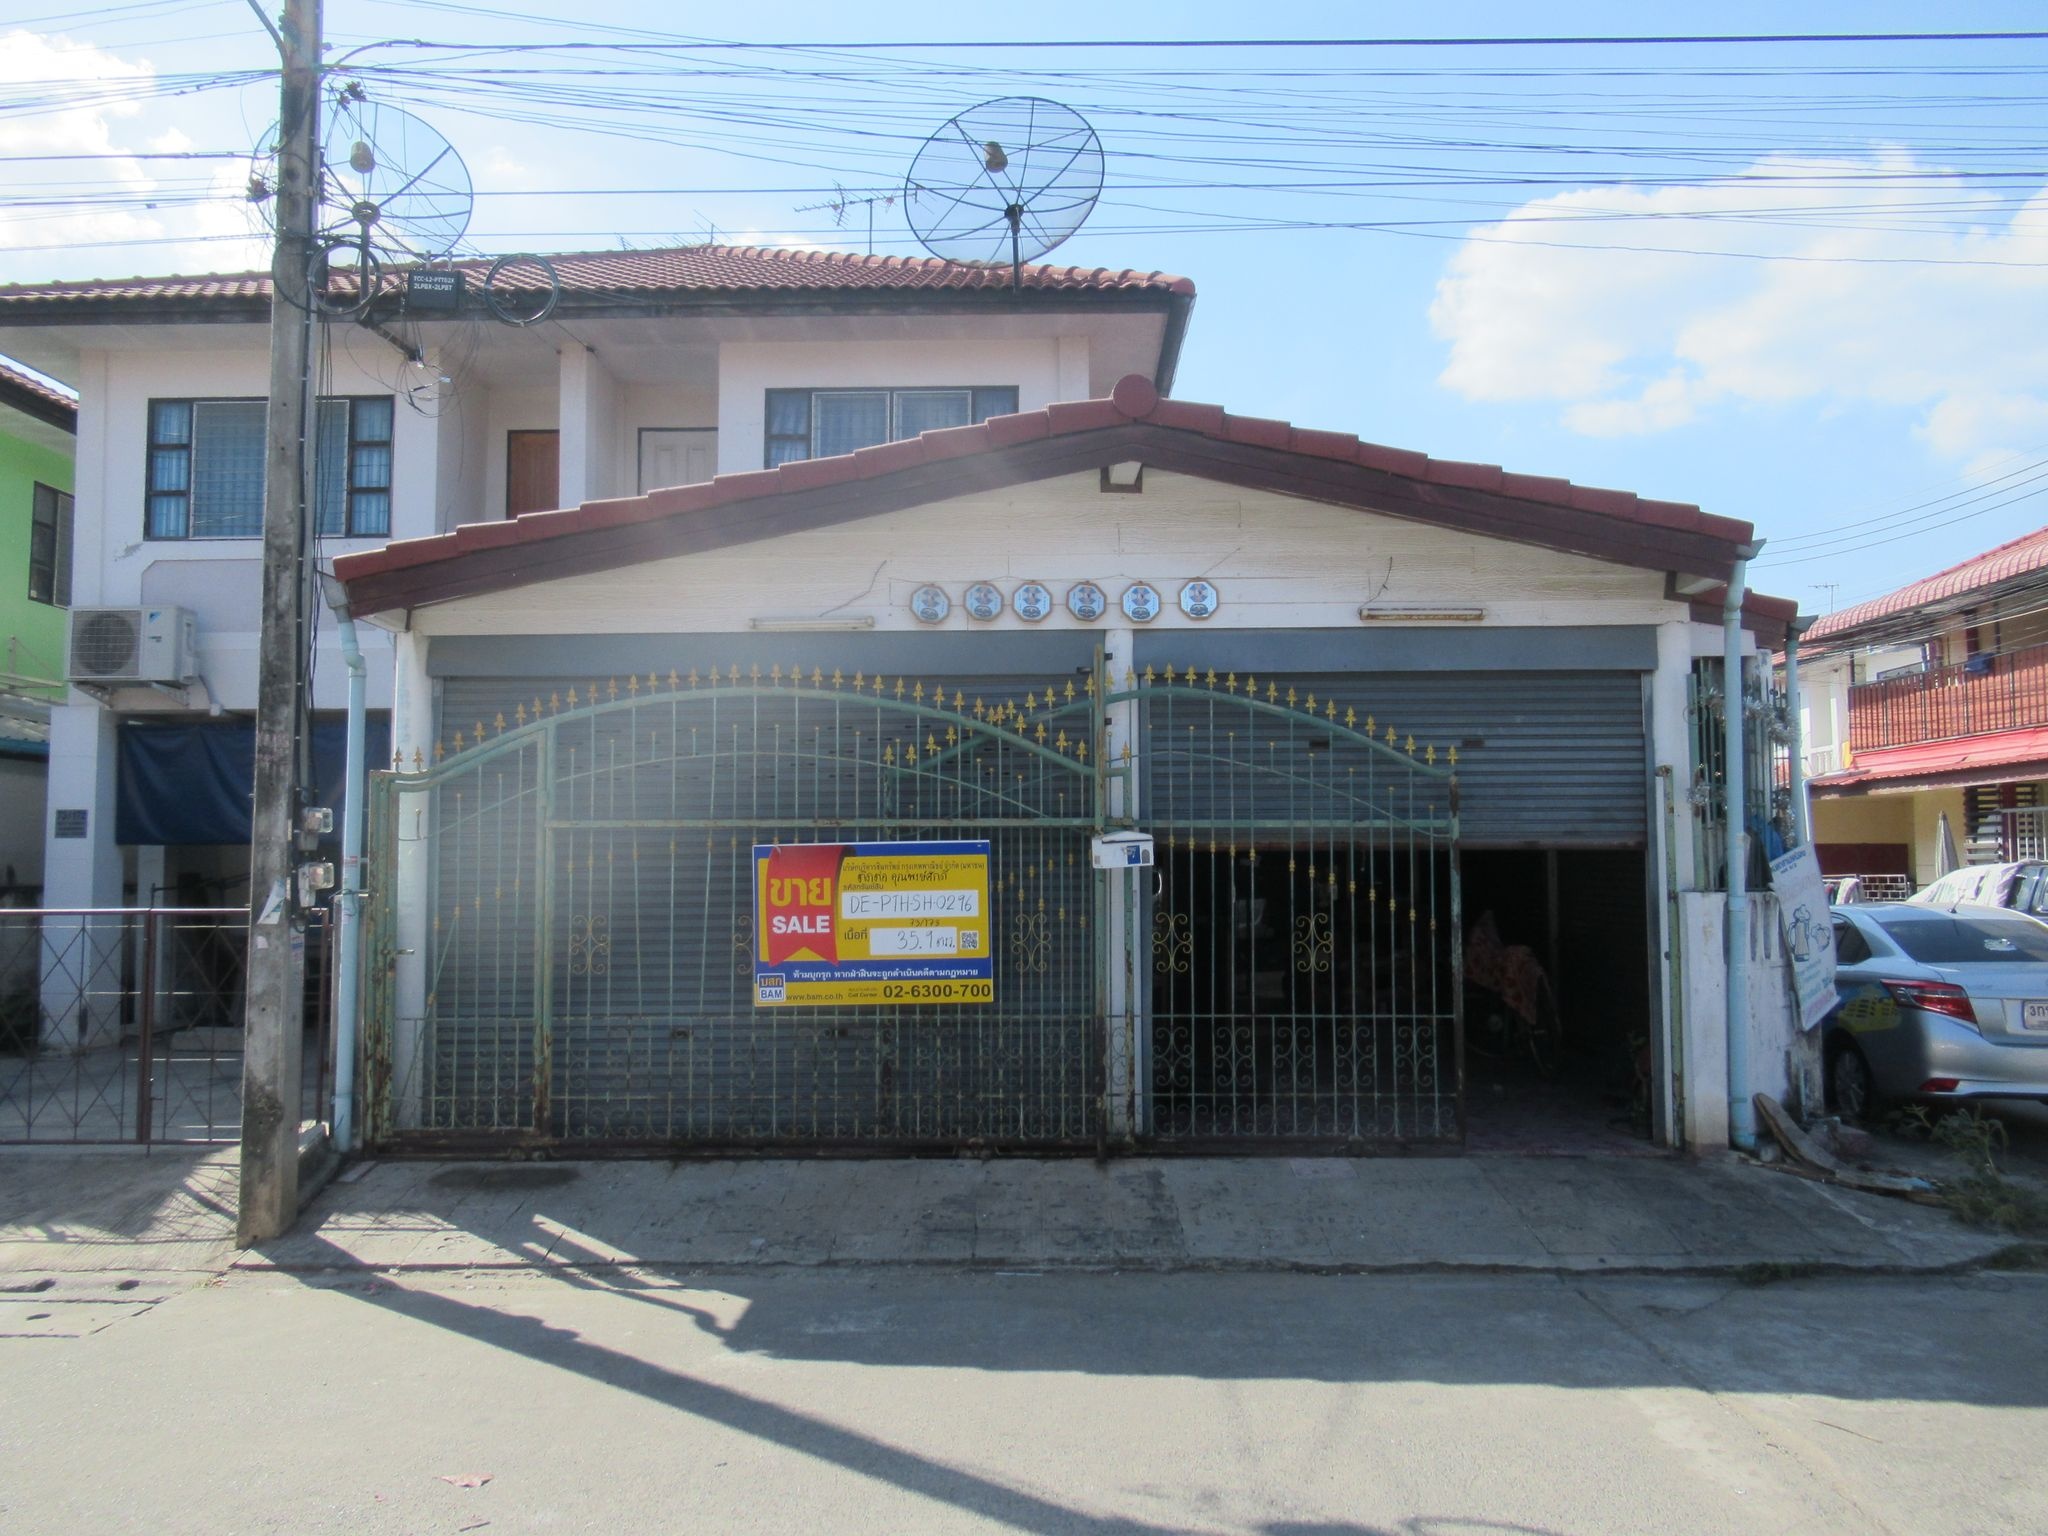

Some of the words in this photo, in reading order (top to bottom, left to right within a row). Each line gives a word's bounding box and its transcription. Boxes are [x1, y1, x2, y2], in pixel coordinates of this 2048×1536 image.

[770, 878, 832, 907] ขาย
[772, 915, 831, 934] SALE
[844, 927, 868, 941] เนื้อที่
[792, 969, 831, 981] ห้ามบุกรุก
[834, 967, 979, 980] หากฝ่าฝืนจะถูกดำเนินคดีตามกฎหมาย
[761, 989, 783, 999] BAM
[786, 992, 844, 1001] www.bam.co.th
[883, 983, 991, 998] 02-6300-700
